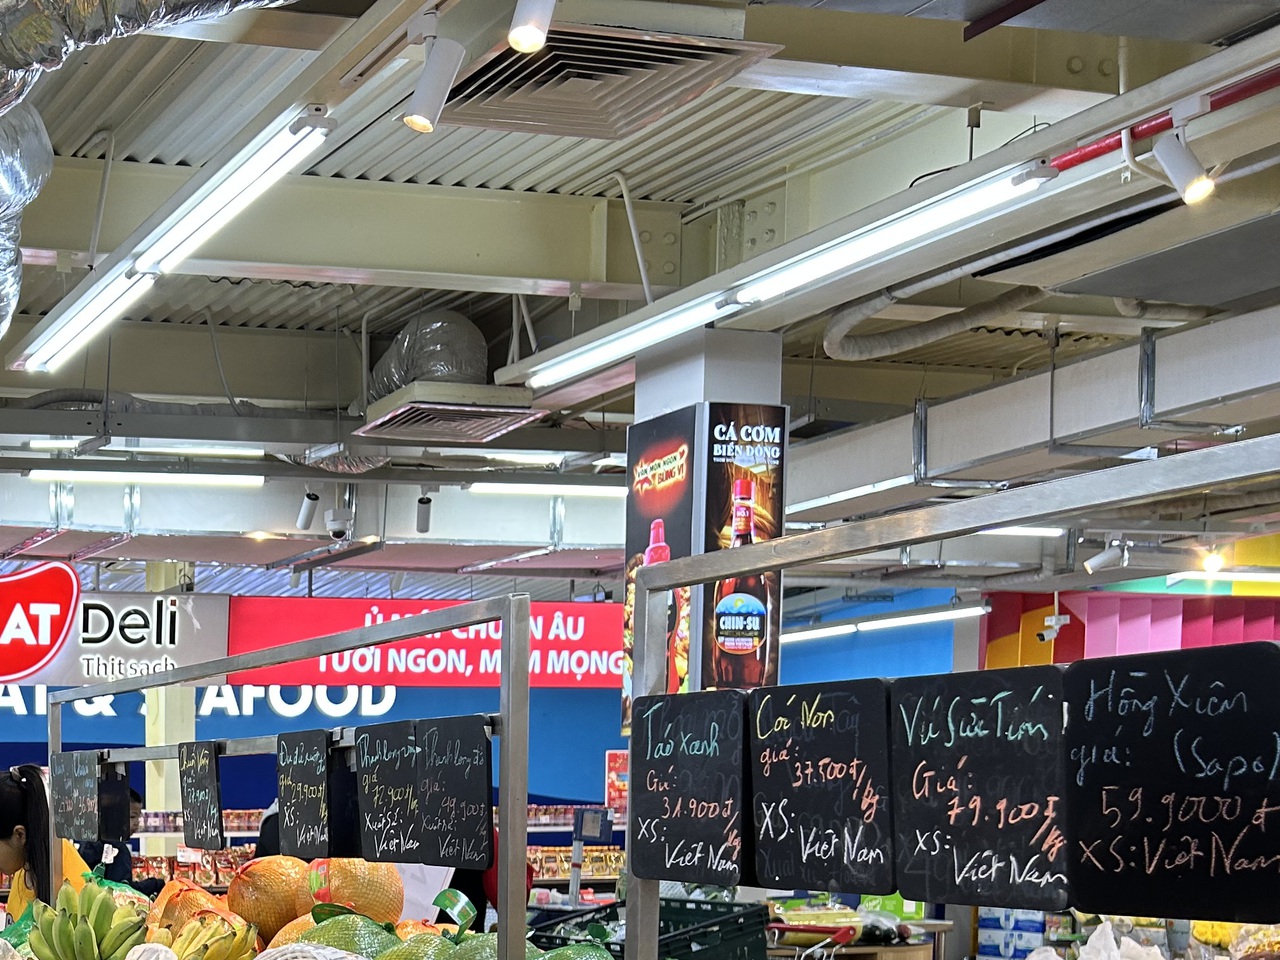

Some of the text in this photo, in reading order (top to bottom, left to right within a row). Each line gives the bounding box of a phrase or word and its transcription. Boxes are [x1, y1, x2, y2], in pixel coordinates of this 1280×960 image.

[714, 421, 781, 443] CÁ CƠM
[81, 598, 178, 646] Deli
[548, 611, 585, 640] ÂU
[720, 615, 760, 631] CHIN-SU
[387, 648, 473, 677] NGON,
[546, 649, 623, 681] MỌNG
[843, 820, 884, 864] Nam
[914, 829, 952, 856] XS:
